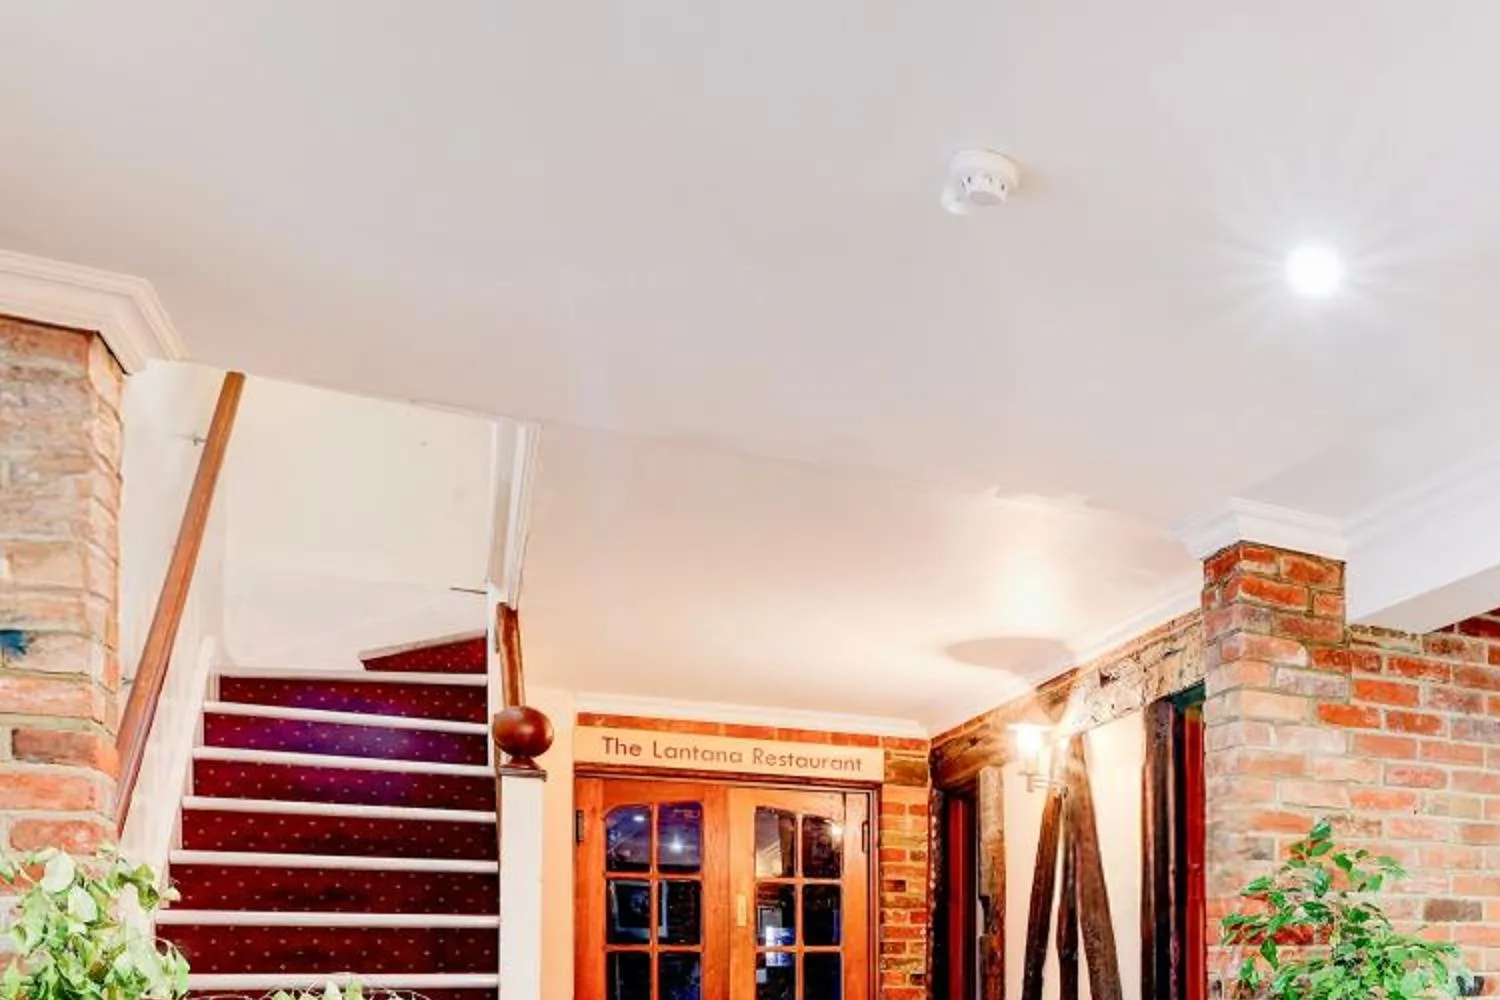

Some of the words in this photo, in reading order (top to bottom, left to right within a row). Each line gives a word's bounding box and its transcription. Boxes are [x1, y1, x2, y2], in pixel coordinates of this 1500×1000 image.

[602, 736, 642, 757] The
[653, 741, 743, 764] Lantana
[752, 747, 863, 772] Restaurant
